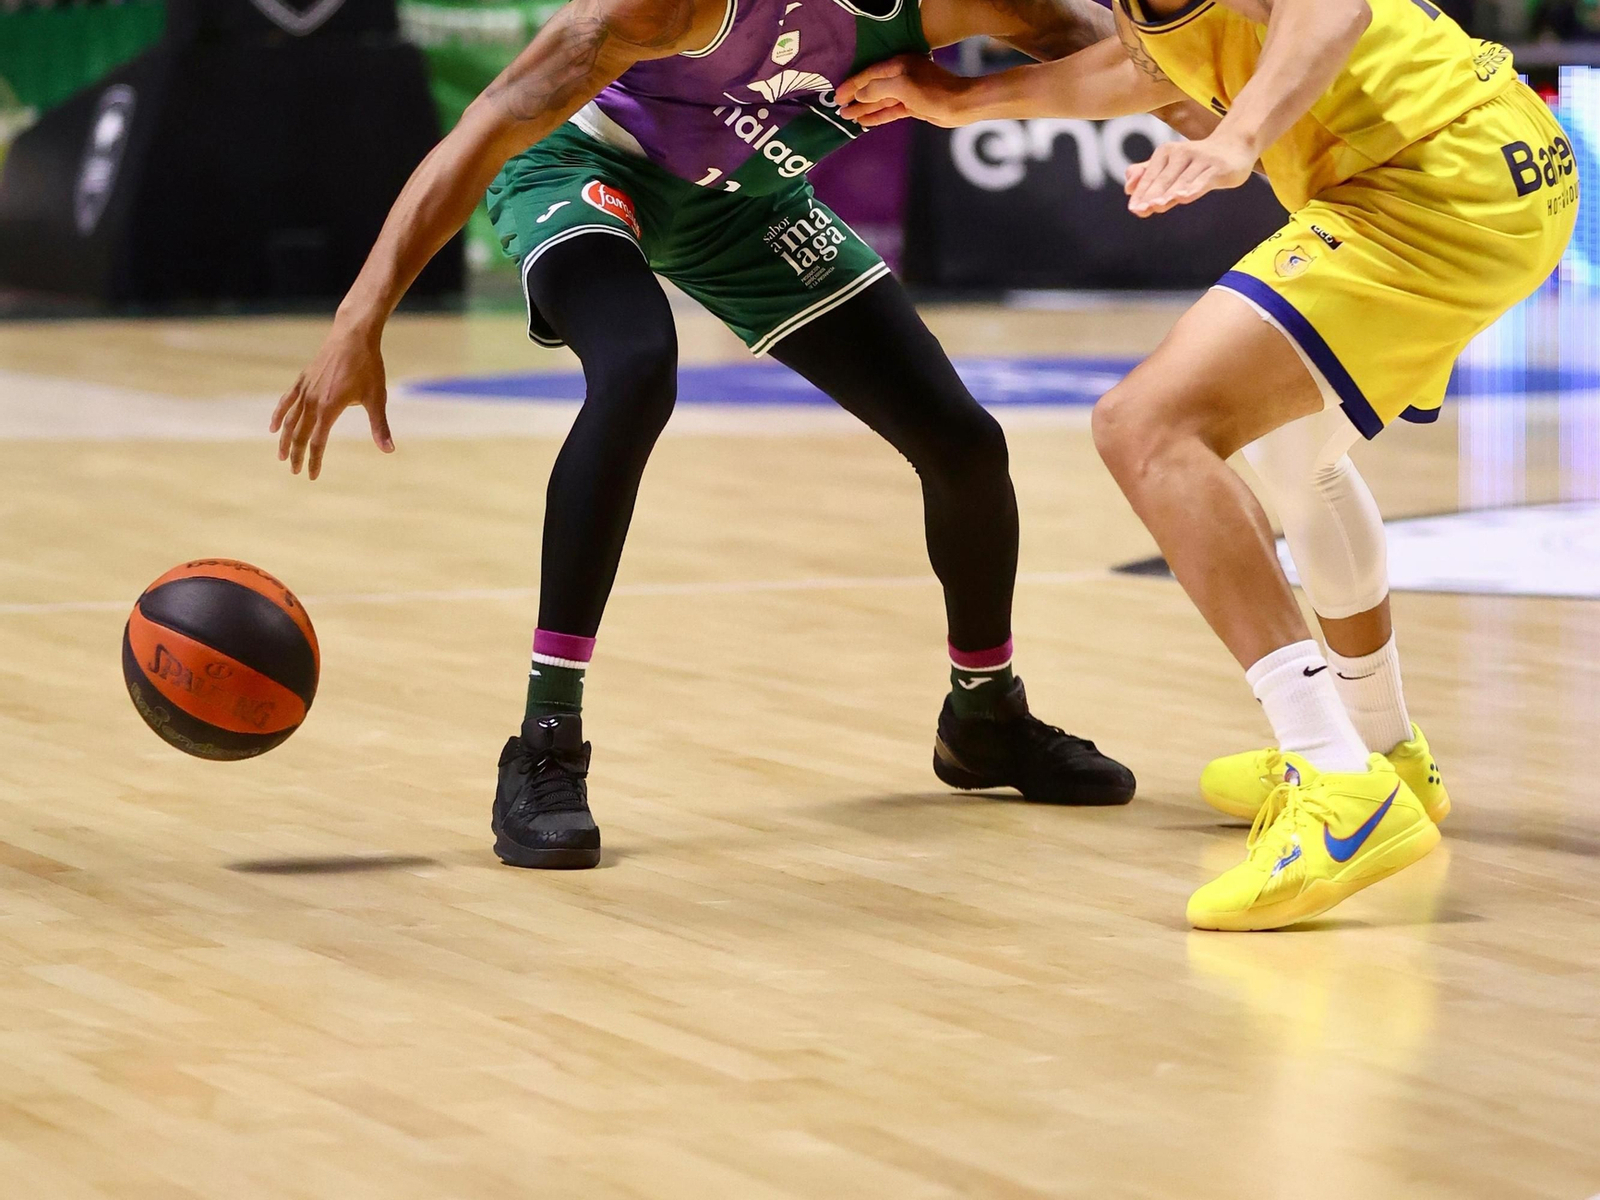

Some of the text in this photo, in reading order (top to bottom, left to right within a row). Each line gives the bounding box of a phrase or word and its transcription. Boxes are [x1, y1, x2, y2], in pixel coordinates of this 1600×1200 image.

[763, 216, 791, 244] sabor
[770, 198, 833, 253] a má
[780, 226, 847, 276] laga
[148, 644, 276, 729] SPALNG
